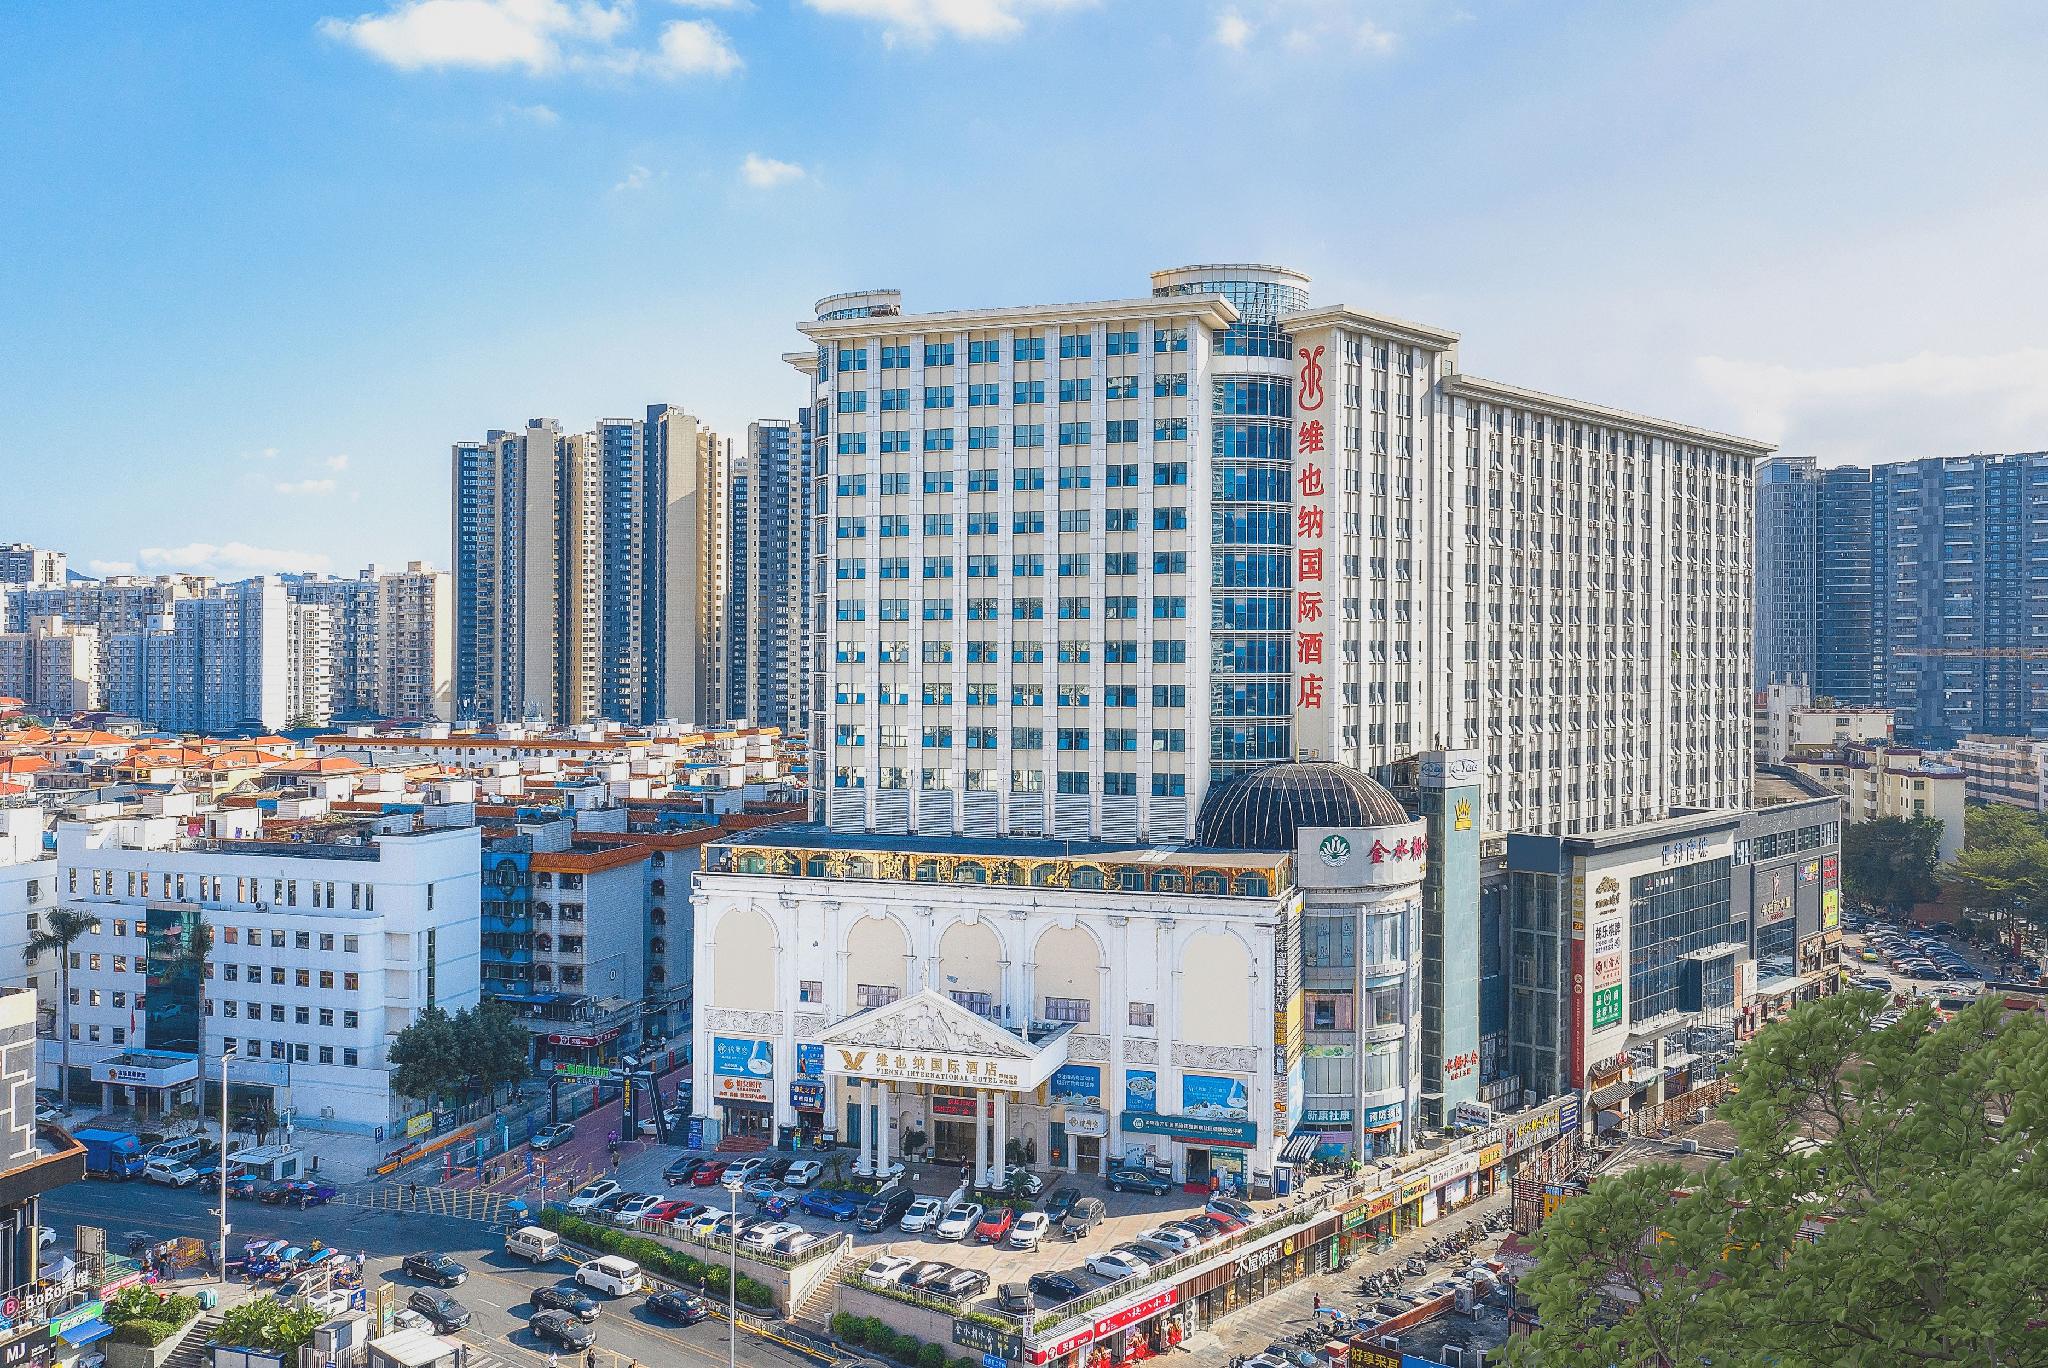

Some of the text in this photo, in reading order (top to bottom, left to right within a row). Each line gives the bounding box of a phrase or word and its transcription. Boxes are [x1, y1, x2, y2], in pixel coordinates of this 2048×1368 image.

[1297, 419, 1326, 708] 维也纳国际酒店
[875, 1053, 998, 1077] 维也纳国际酒店
[876, 1067, 904, 1077] VIENNA
[907, 1070, 969, 1082] INTERNATIONAL
[972, 1075, 998, 1084] HOTEL
[1234, 1246, 1278, 1278] 木屋烧烤
[6, 1342, 26, 1364] MJ
